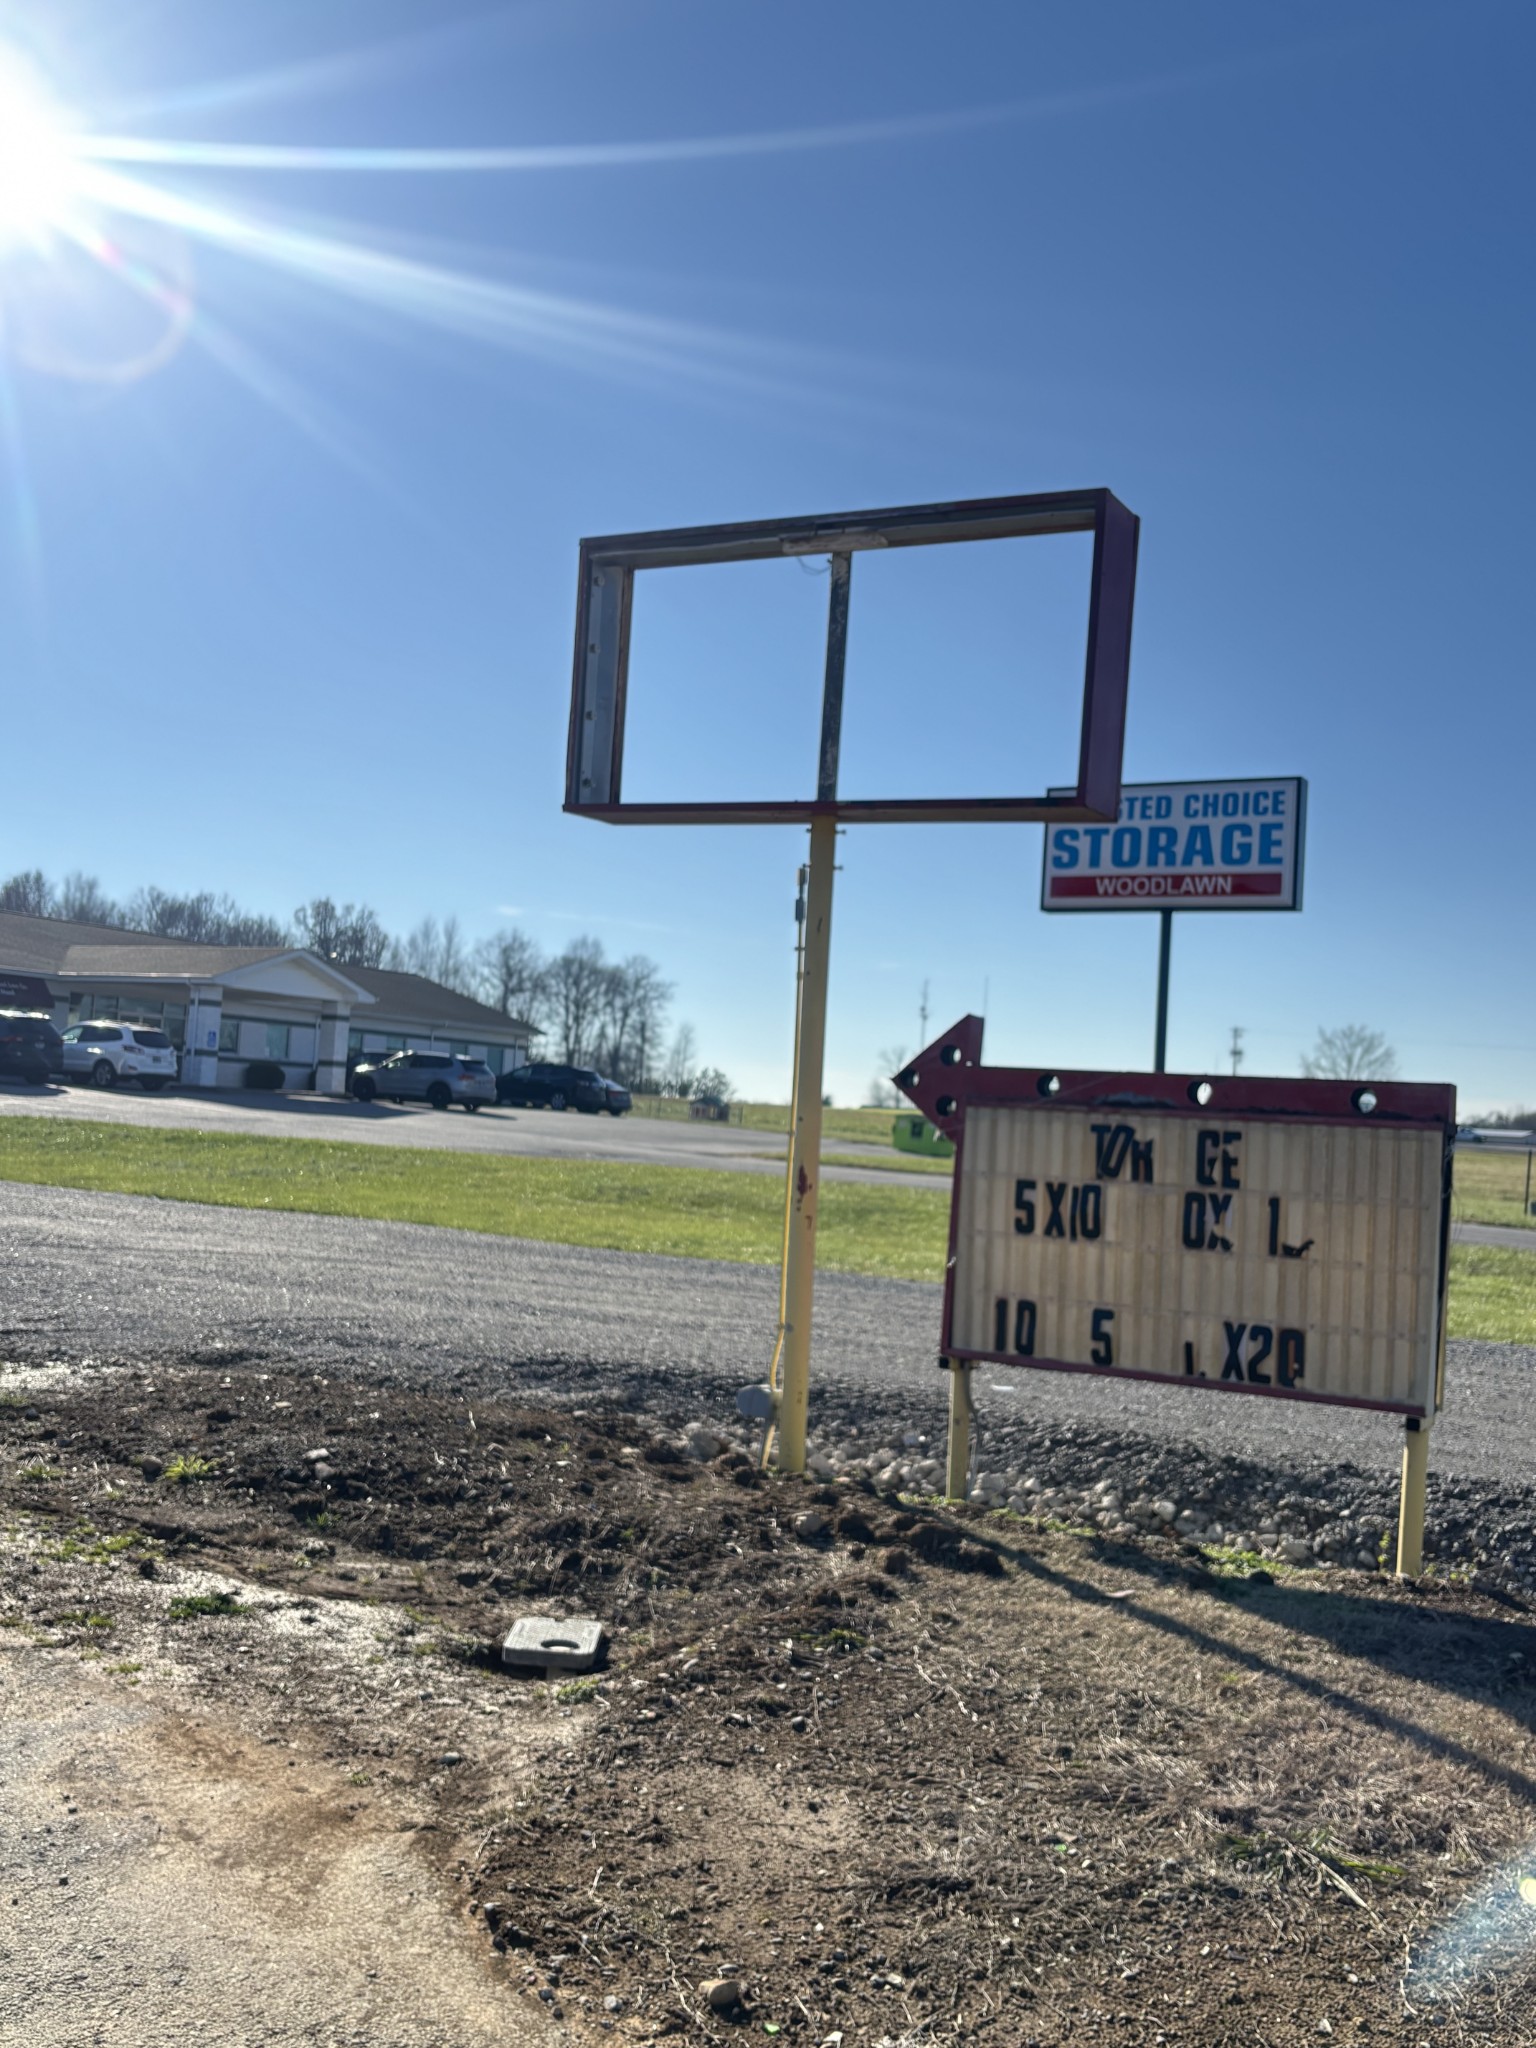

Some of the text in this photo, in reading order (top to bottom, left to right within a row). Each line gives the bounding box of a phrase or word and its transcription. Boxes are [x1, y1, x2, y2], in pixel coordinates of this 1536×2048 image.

[1118, 790, 1286, 821] TED CHOICE
[1052, 822, 1284, 869] STORAGE
[1096, 876, 1232, 896] WOODLAWN
[1014, 1179, 1102, 1242] 5X10
[1091, 1308, 1115, 1366] 5
